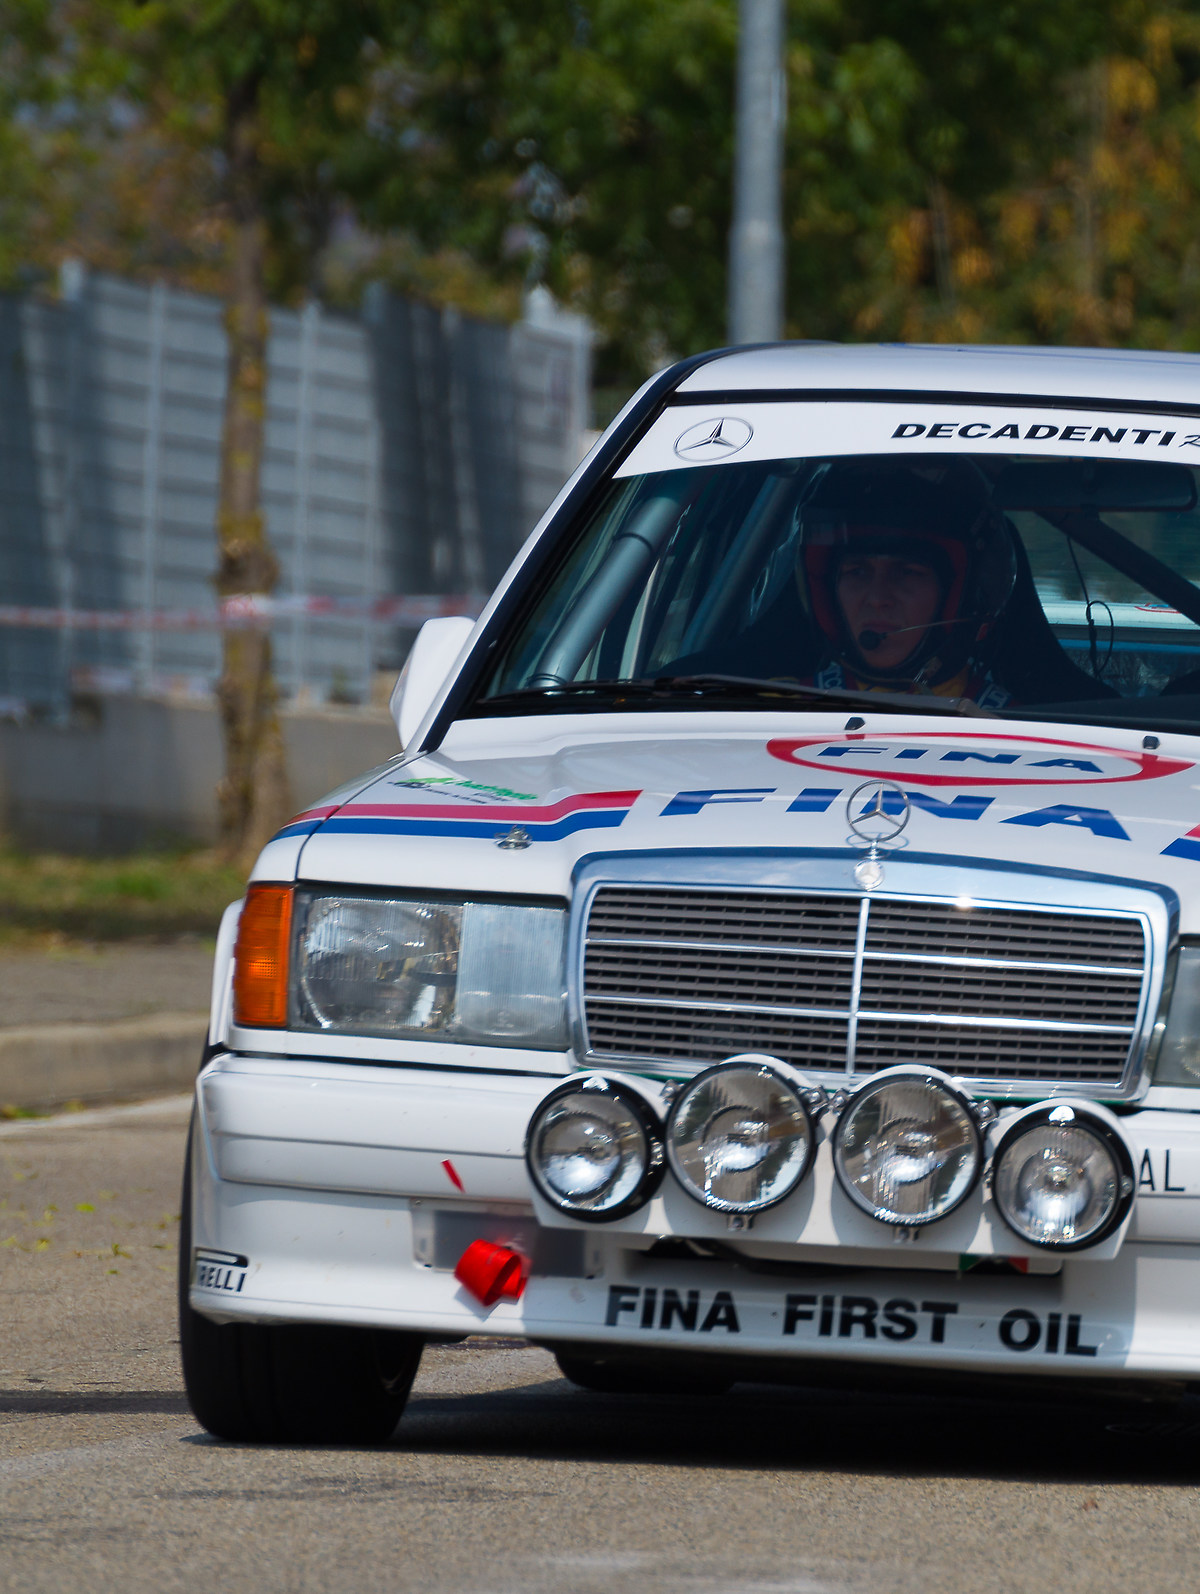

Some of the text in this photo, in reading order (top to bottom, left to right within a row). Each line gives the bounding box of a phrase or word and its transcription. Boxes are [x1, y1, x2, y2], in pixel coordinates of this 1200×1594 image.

[891, 422, 1178, 447] DECADENTI
[816, 745, 1105, 774] FINA
[658, 786, 1132, 842] FINA
[1139, 1148, 1186, 1192] AL
[605, 1284, 1099, 1358] FINA FIRST OIL
